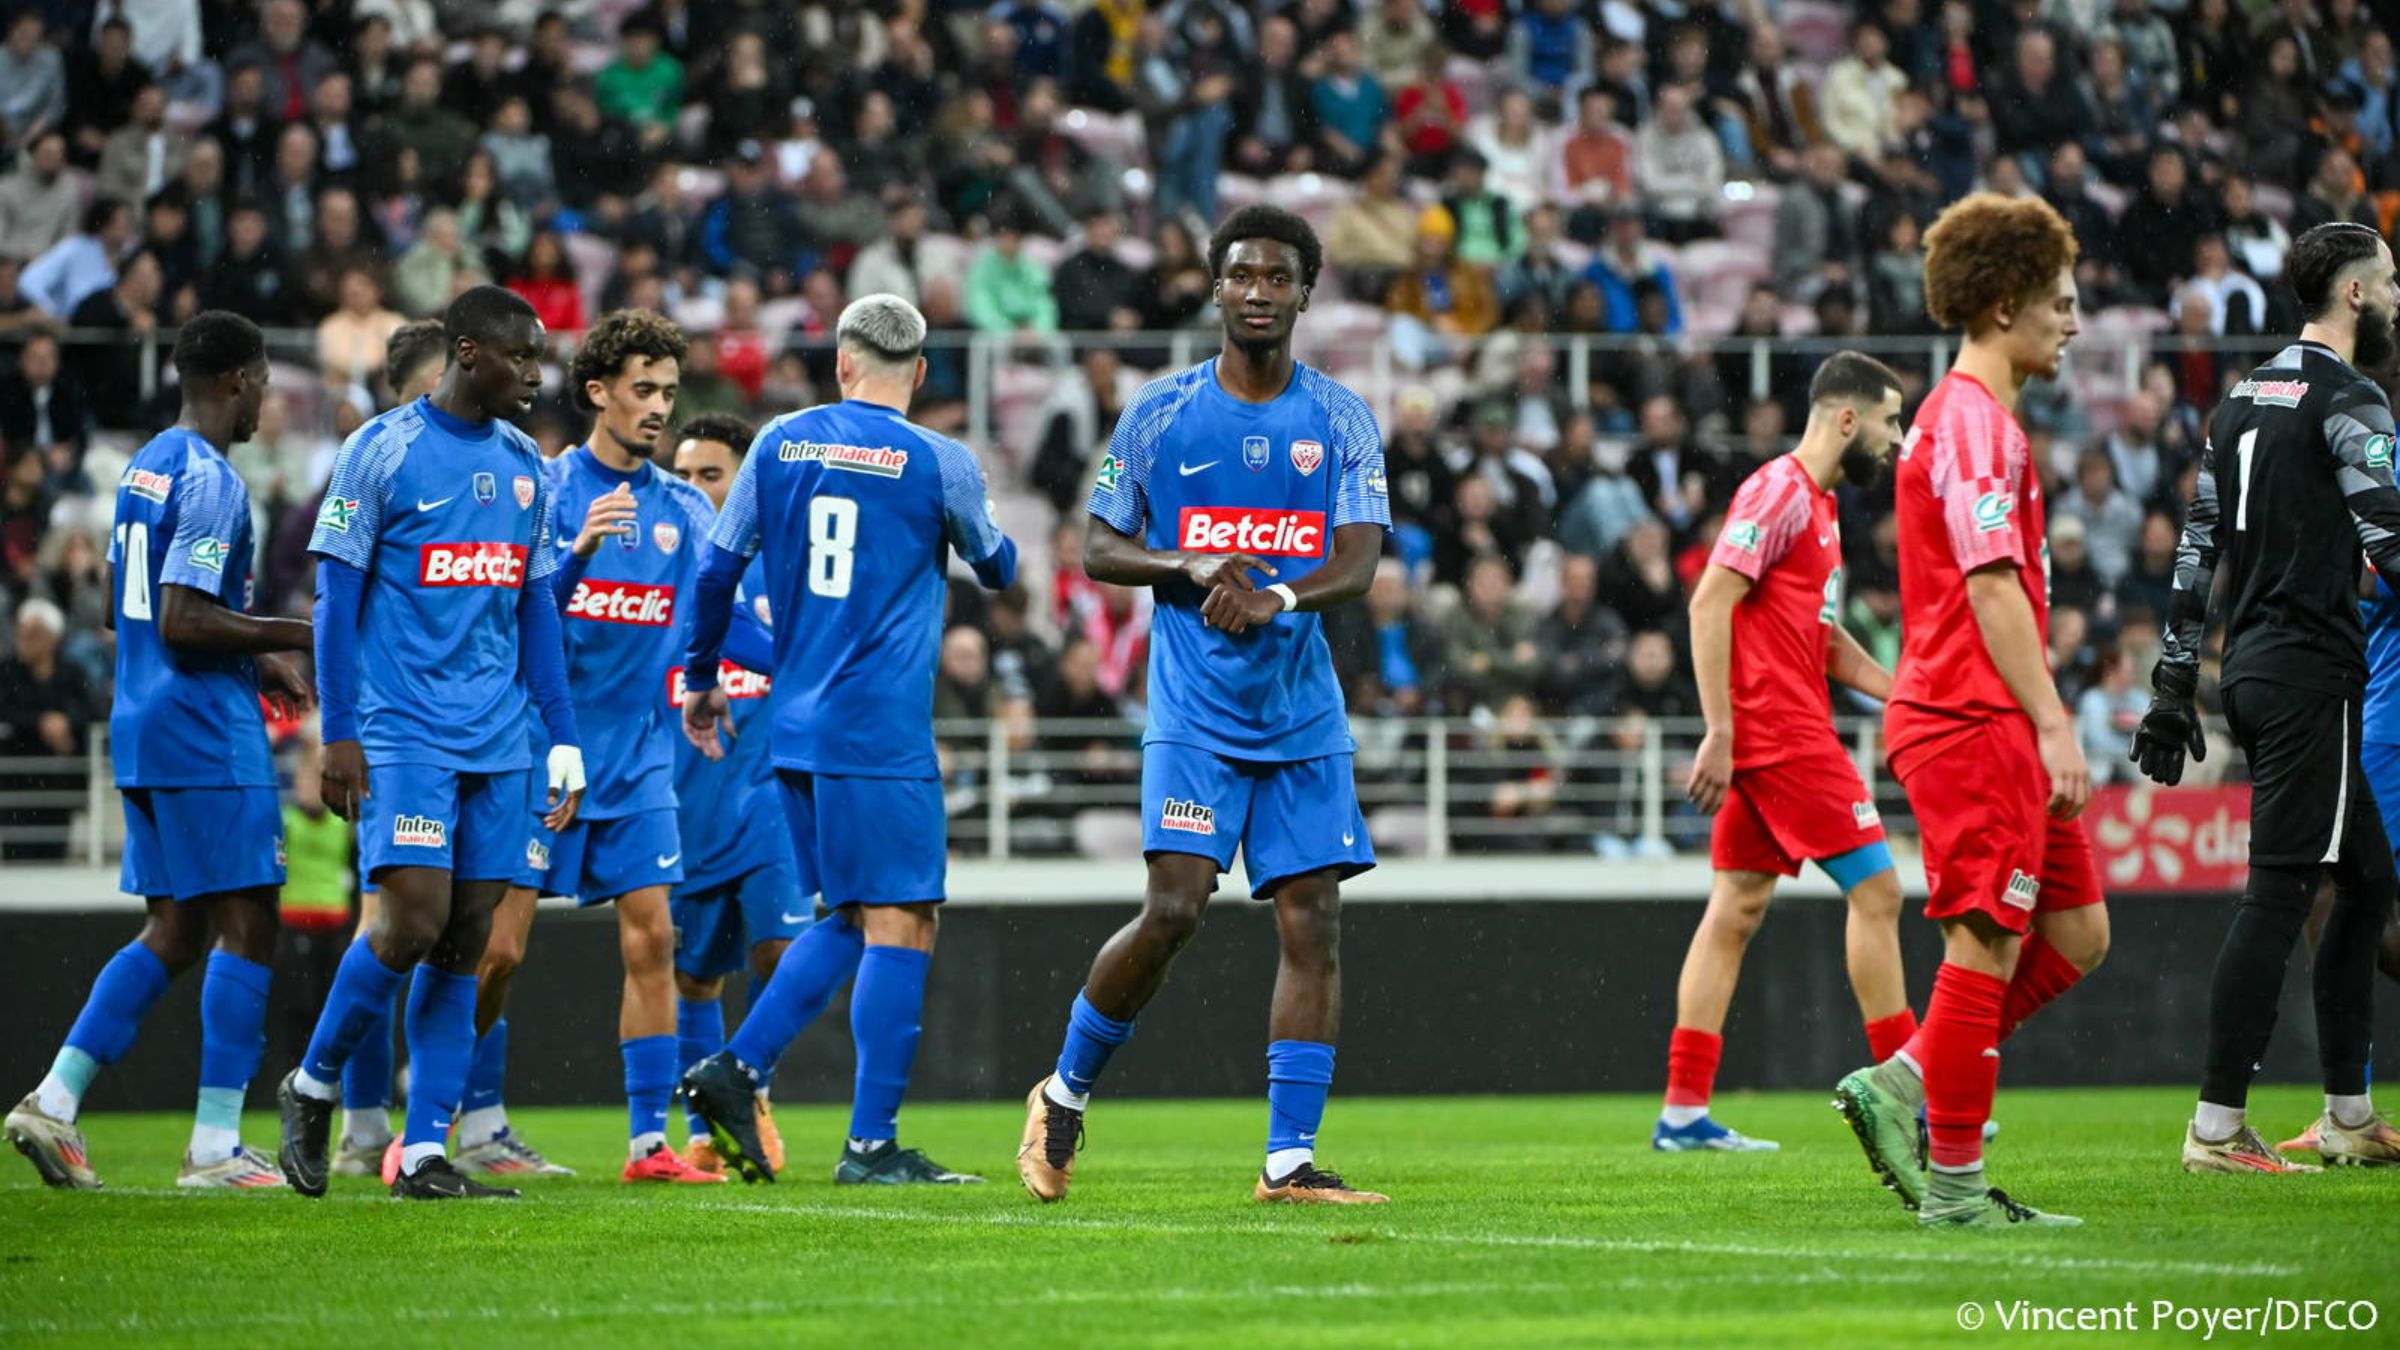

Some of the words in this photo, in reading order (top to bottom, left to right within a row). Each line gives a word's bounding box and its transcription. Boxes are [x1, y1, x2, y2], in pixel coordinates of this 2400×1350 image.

[2236, 427, 2259, 531] 1
[116, 521, 153, 621] 10
[809, 496, 858, 599] 8
[1183, 513, 1319, 553] Betclic
[565, 581, 672, 623] Betclic
